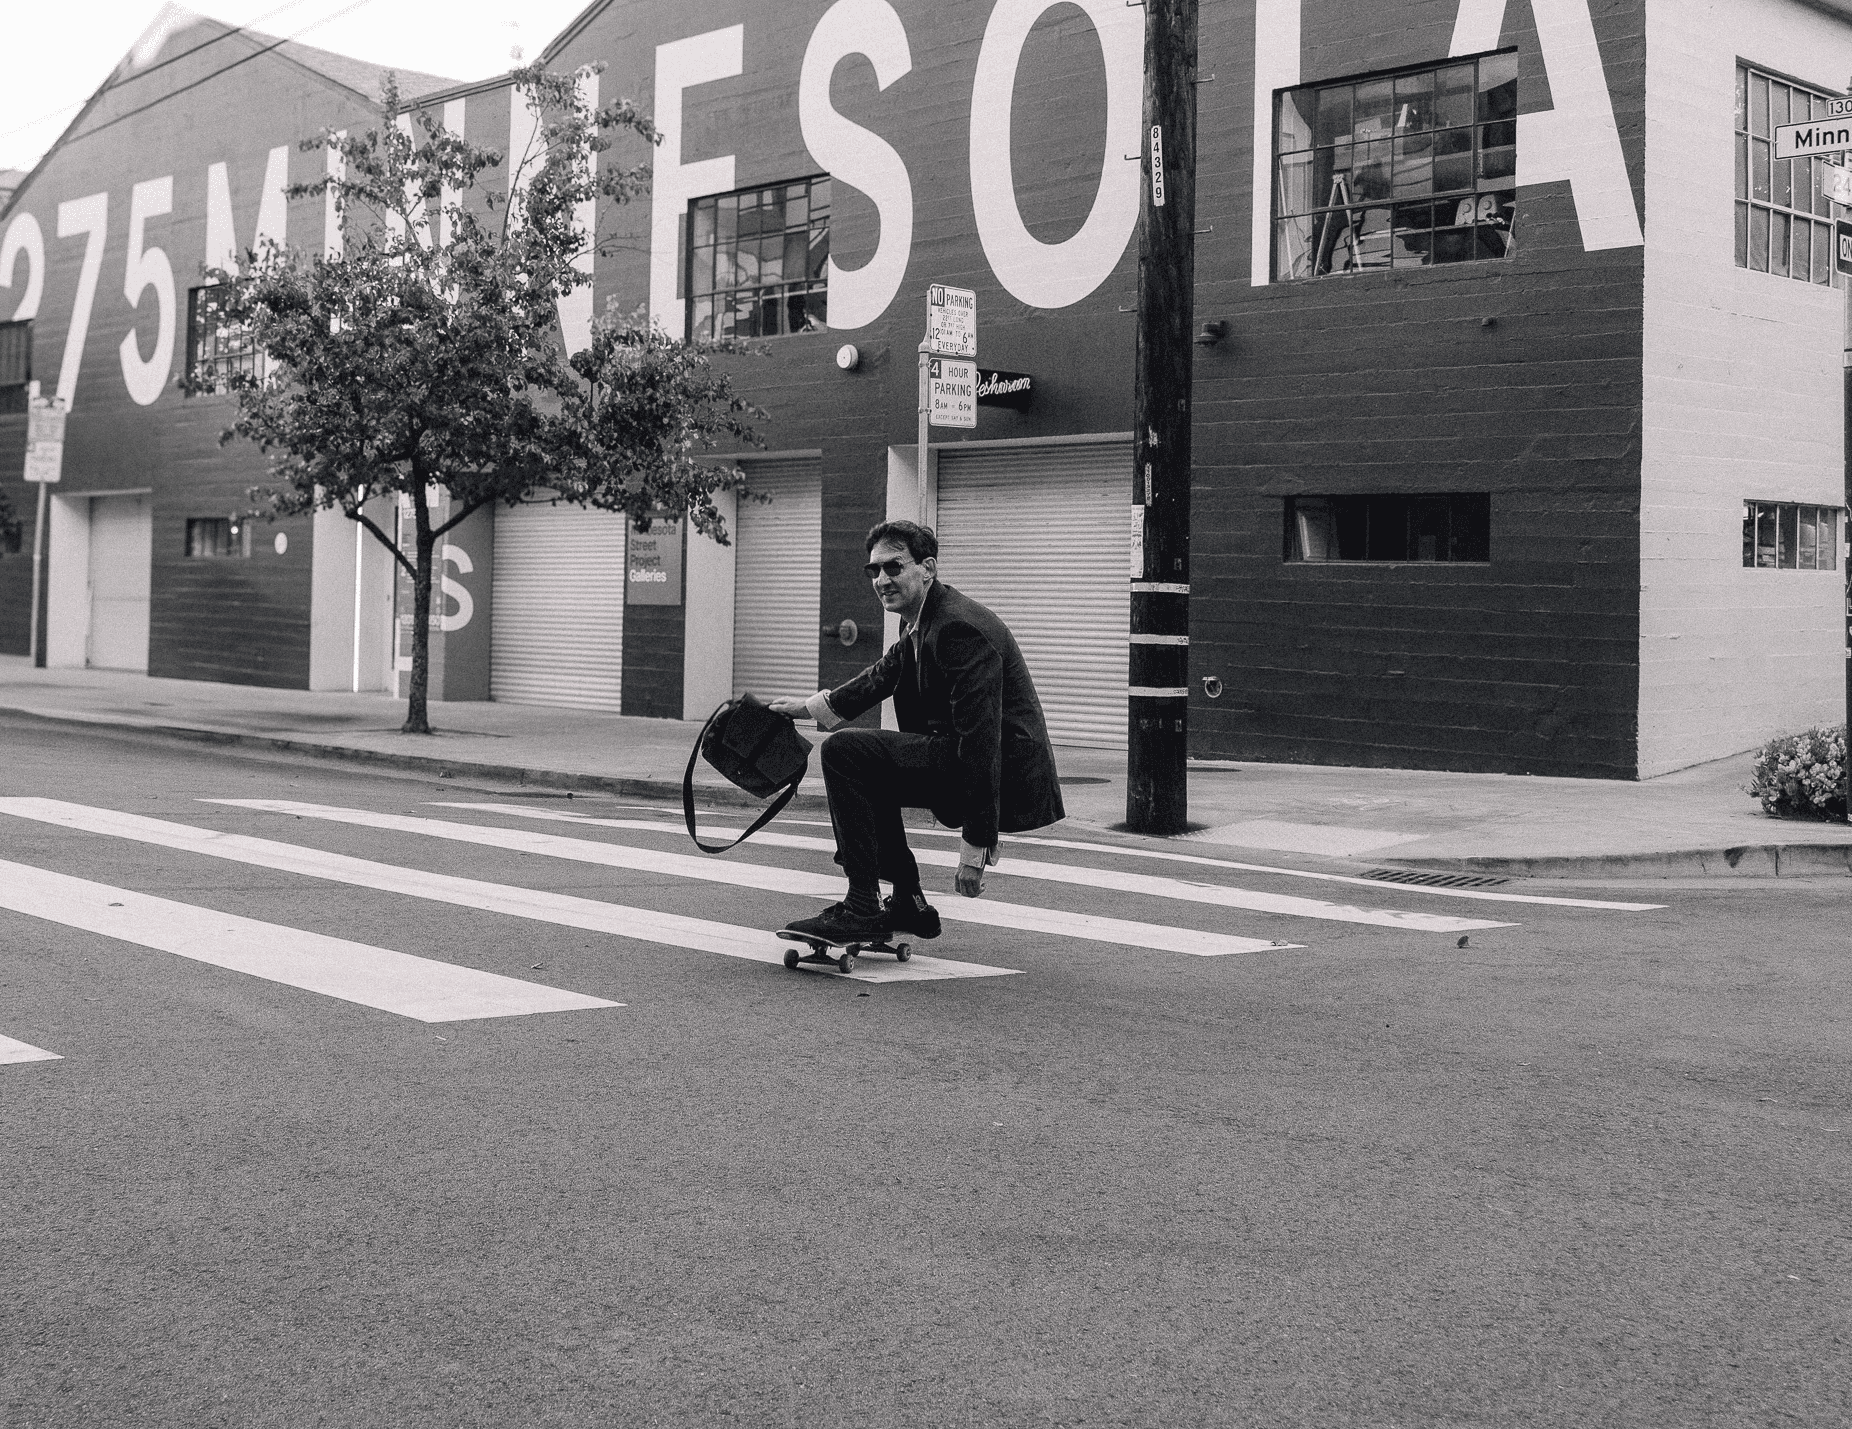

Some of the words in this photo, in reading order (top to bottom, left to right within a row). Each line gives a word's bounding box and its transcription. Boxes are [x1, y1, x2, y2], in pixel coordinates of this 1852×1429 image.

[1795, 127, 1850, 149] Minn
[1152, 127, 1162, 199] 84329
[931, 286, 944, 306] NO
[946, 293, 973, 310] PARKING
[937, 340, 969, 353] EVERYDAY
[930, 361, 940, 377] 4
[948, 366, 969, 379] HOUR
[934, 382, 972, 397] PARKING
[630, 539, 657, 551] Street
[630, 554, 661, 569] Project
[629, 568, 667, 582] Galleries
